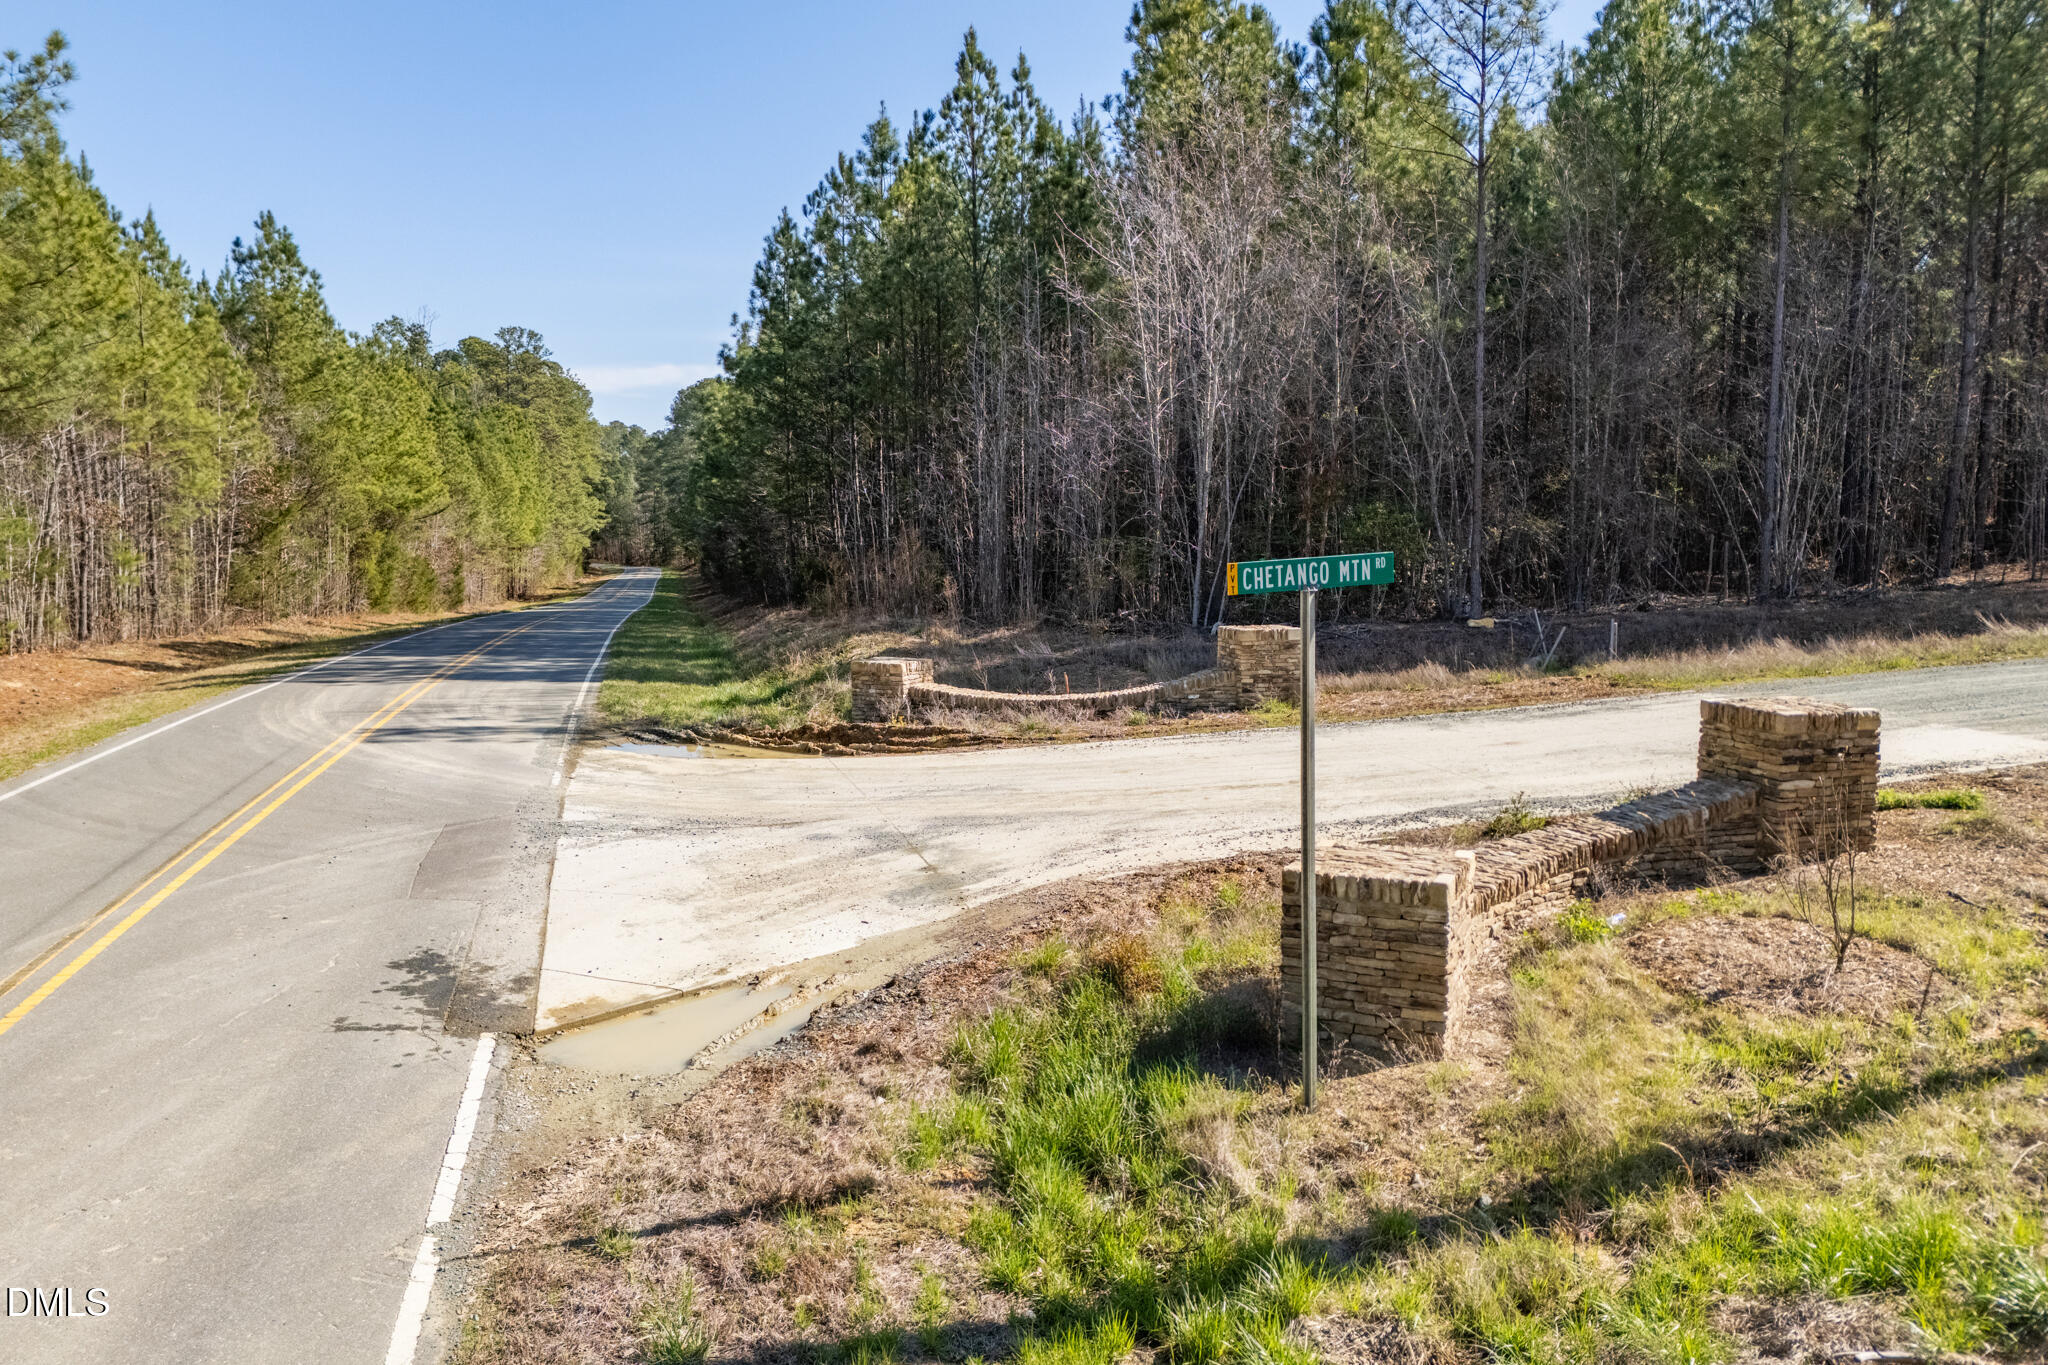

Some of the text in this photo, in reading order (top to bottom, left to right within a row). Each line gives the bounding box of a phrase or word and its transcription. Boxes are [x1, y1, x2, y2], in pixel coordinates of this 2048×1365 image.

[1242, 556, 1386, 590] CHETANGO MTN RD
